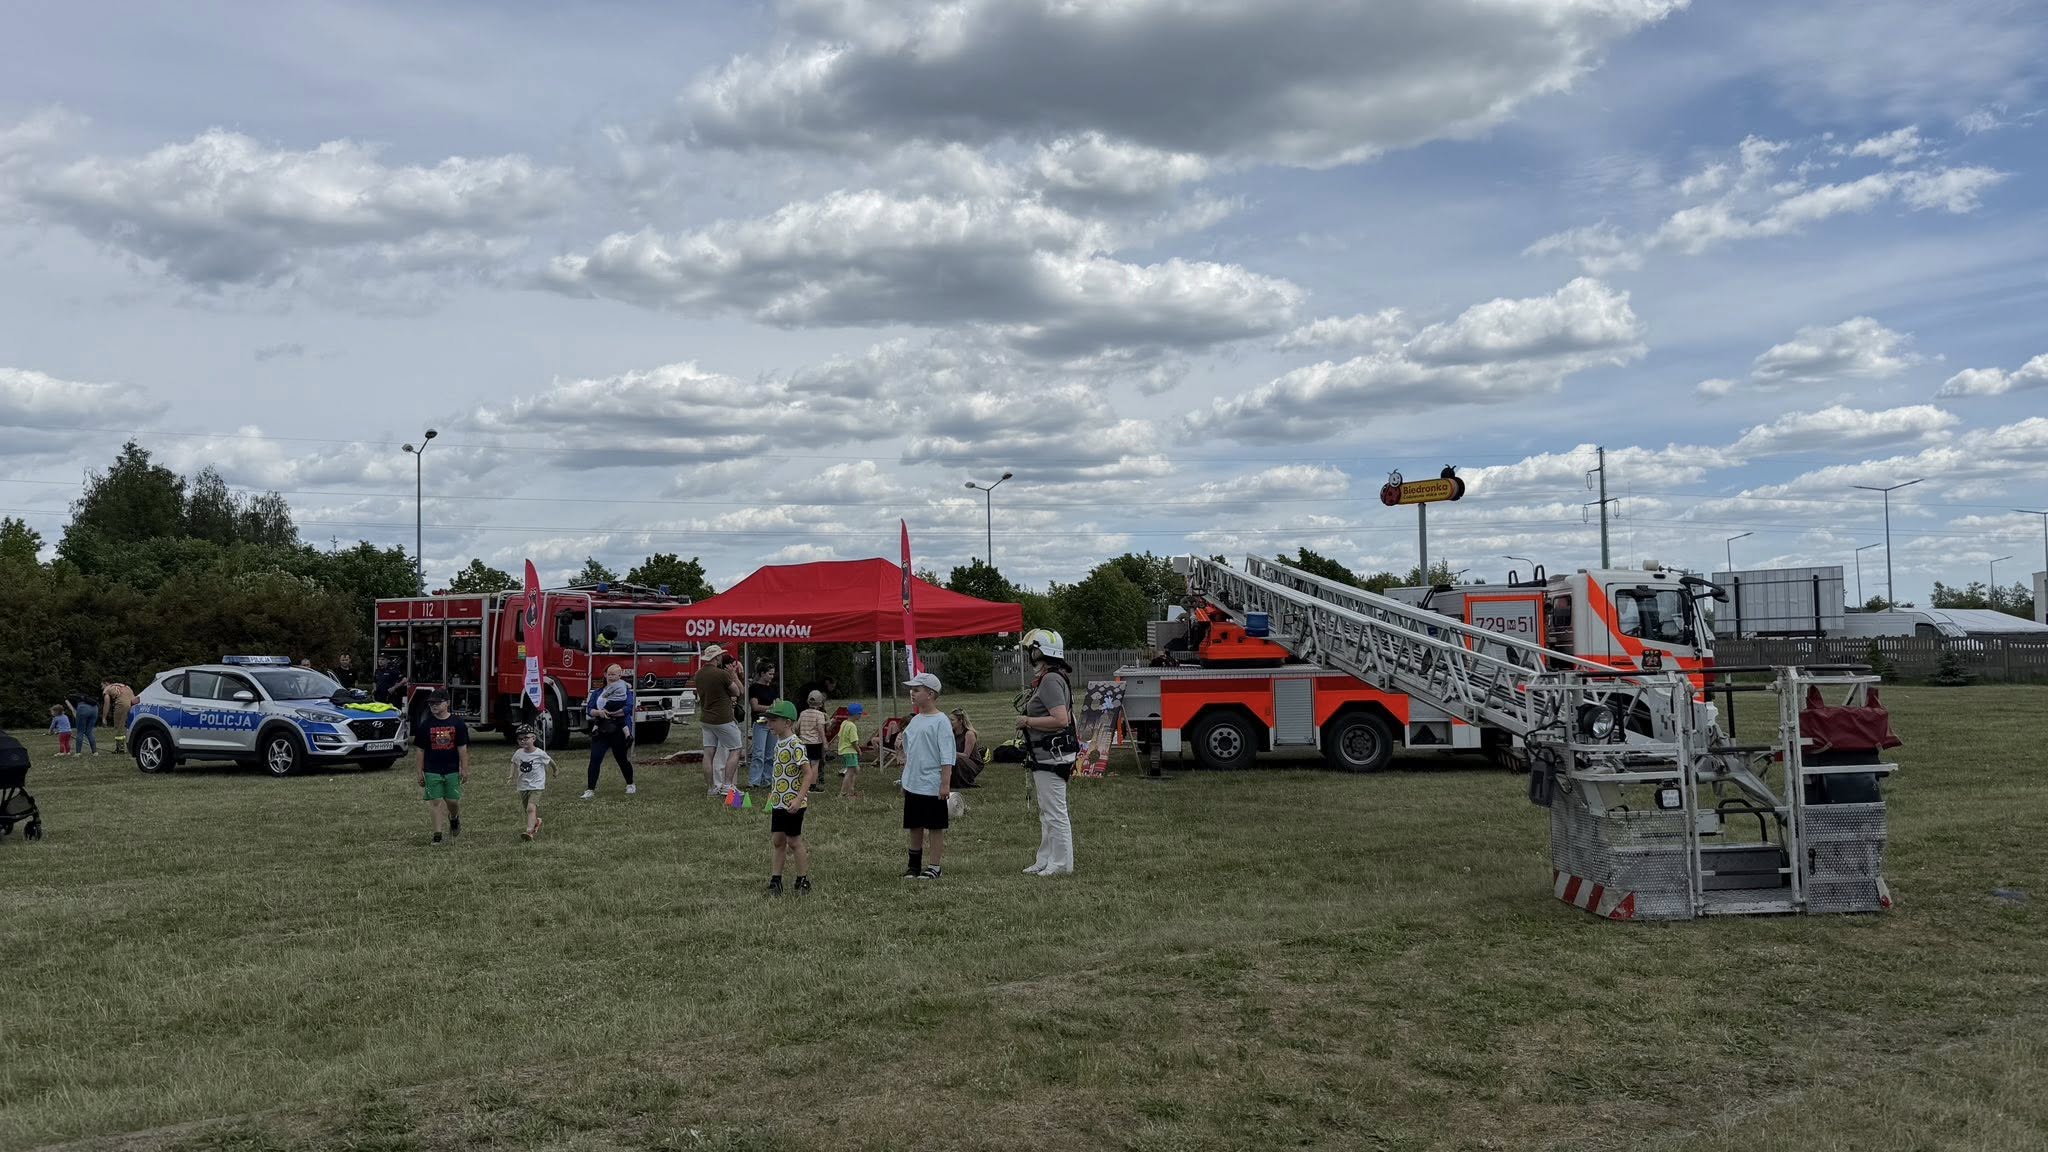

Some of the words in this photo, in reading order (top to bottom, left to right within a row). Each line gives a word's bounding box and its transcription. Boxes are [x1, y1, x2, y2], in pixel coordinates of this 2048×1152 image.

[1403, 484, 1448, 495] Biedronka
[422, 603, 433, 617] 112
[685, 619, 715, 637] OSP
[719, 619, 812, 639] Mszczonów
[200, 713, 252, 727] POLICJA
